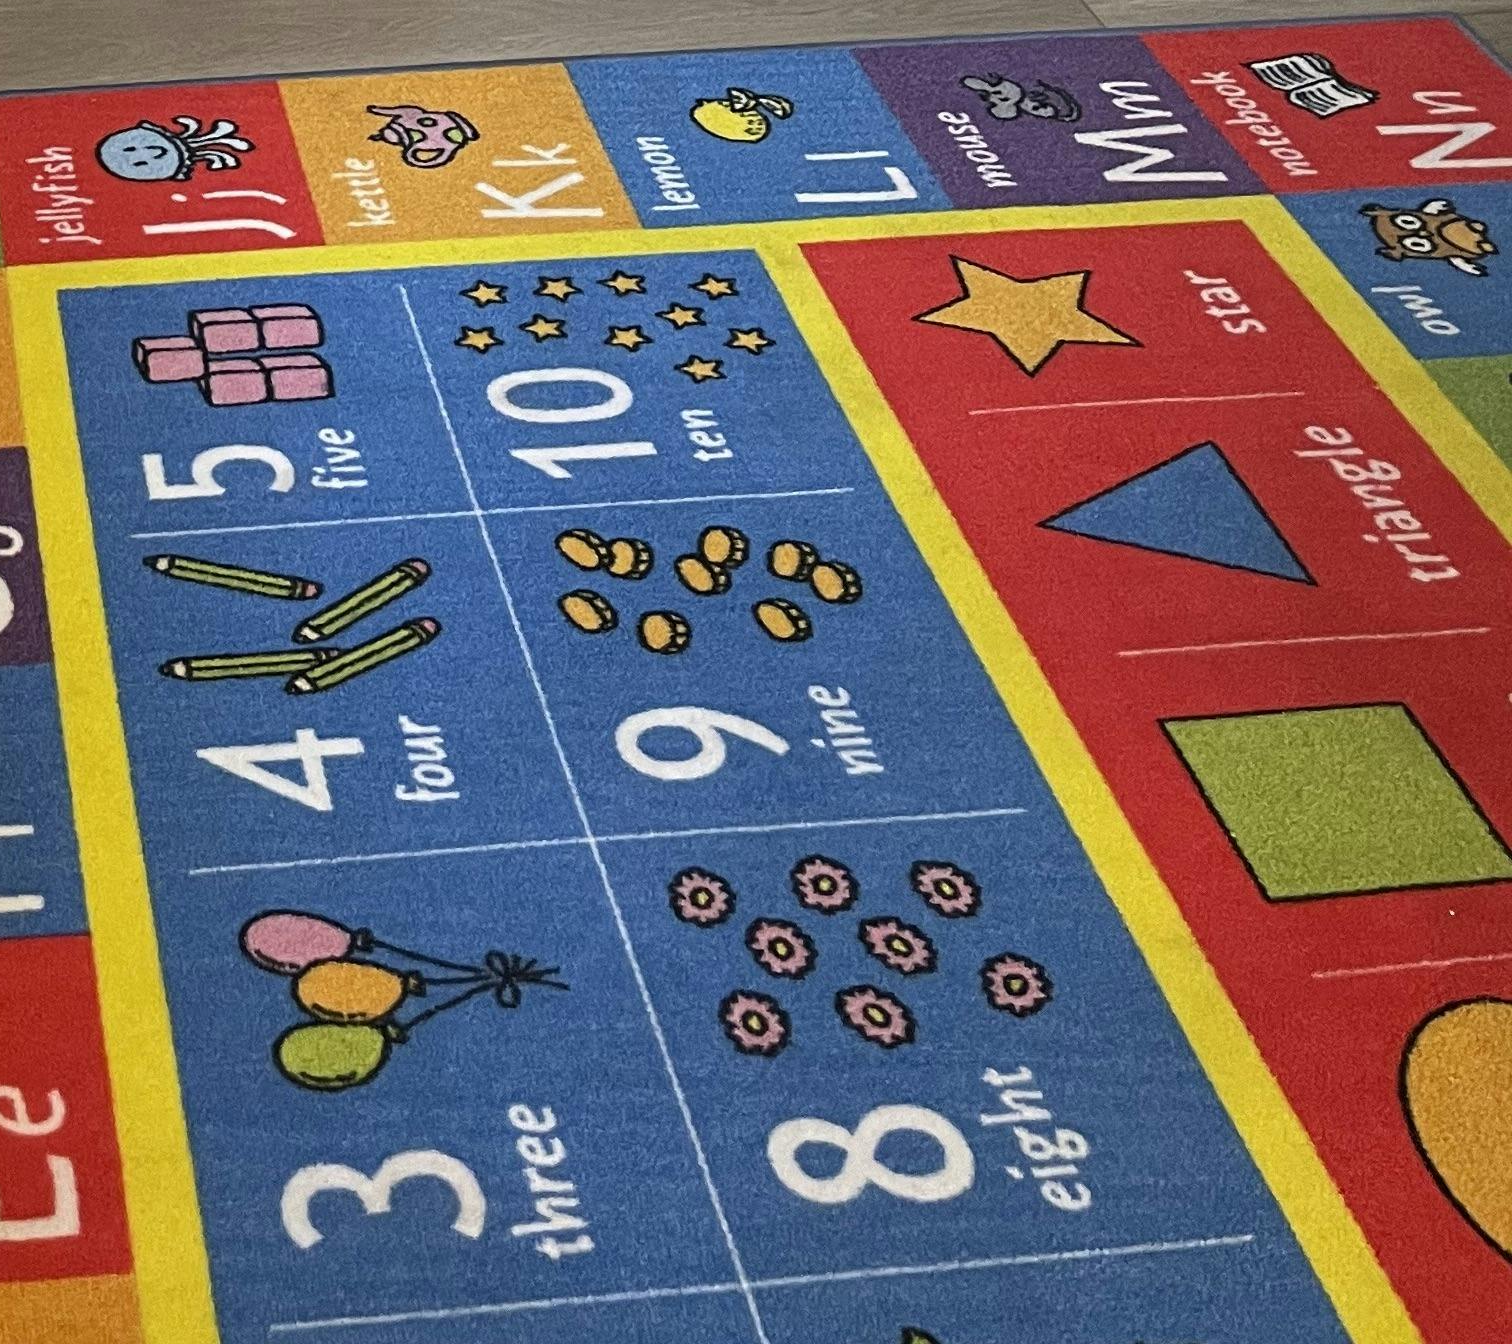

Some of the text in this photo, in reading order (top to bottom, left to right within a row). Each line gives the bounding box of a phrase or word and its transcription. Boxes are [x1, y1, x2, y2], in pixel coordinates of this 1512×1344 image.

[936, 111, 1018, 189] mouse
[1073, 80, 1228, 185] Mm
[1190, 70, 1318, 176] notebook
[1376, 90, 1512, 169] Nn
[38, 145, 104, 246] jellyfish
[331, 154, 395, 229] kettle
[472, 141, 604, 220] Kk
[633, 134, 701, 213] lemon
[795, 150, 918, 205] Ll
[142, 189, 297, 239] Jj
[1183, 269, 1268, 335] star
[1371, 284, 1461, 336] owl
[309, 424, 370, 493] five
[487, 367, 659, 480] 10
[674, 407, 733, 464] ten
[141, 442, 296, 502] 5
[1292, 424, 1462, 583] triangle
[195, 727, 365, 813] 4
[394, 713, 459, 805] four
[615, 705, 791, 781] 9
[807, 683, 886, 778] nine
[766, 1103, 976, 1205] 8
[979, 1064, 1091, 1212] eight
[280, 1148, 487, 1250] 3
[510, 1103, 595, 1262] three
